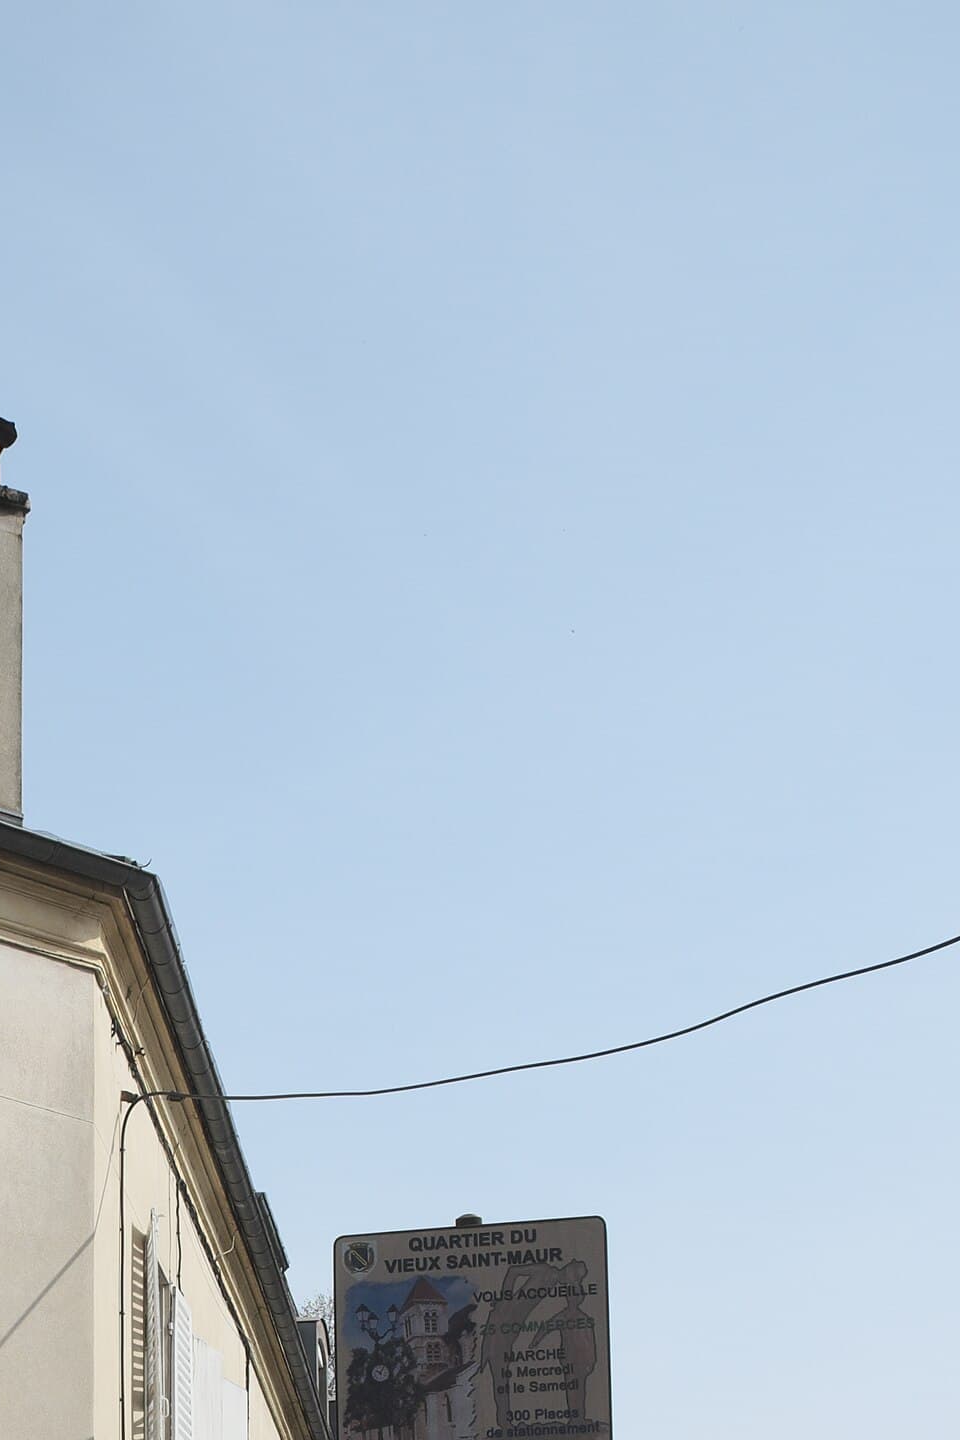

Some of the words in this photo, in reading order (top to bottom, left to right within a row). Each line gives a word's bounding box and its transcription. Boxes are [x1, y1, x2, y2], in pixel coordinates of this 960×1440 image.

[408, 1231, 504, 1252] QUARTIER
[510, 1228, 537, 1244] DU
[384, 1256, 442, 1274] VIEUX
[446, 1247, 563, 1269] SAINT-MAUR
[473, 1287, 513, 1303] VOUS
[517, 1283, 598, 1300] ACCUEILLE
[500, 1317, 595, 1335] COMMERCES
[501, 1366, 513, 1379] le
[515, 1363, 575, 1379] Mercredi
[496, 1384, 510, 1395] et
[513, 1382, 525, 1394] le
[528, 1379, 580, 1393] Samedi
[506, 1408, 530, 1422] 300
[534, 1407, 580, 1421] Places
[486, 1427, 502, 1439] de
[506, 1421, 601, 1438] stationnement
